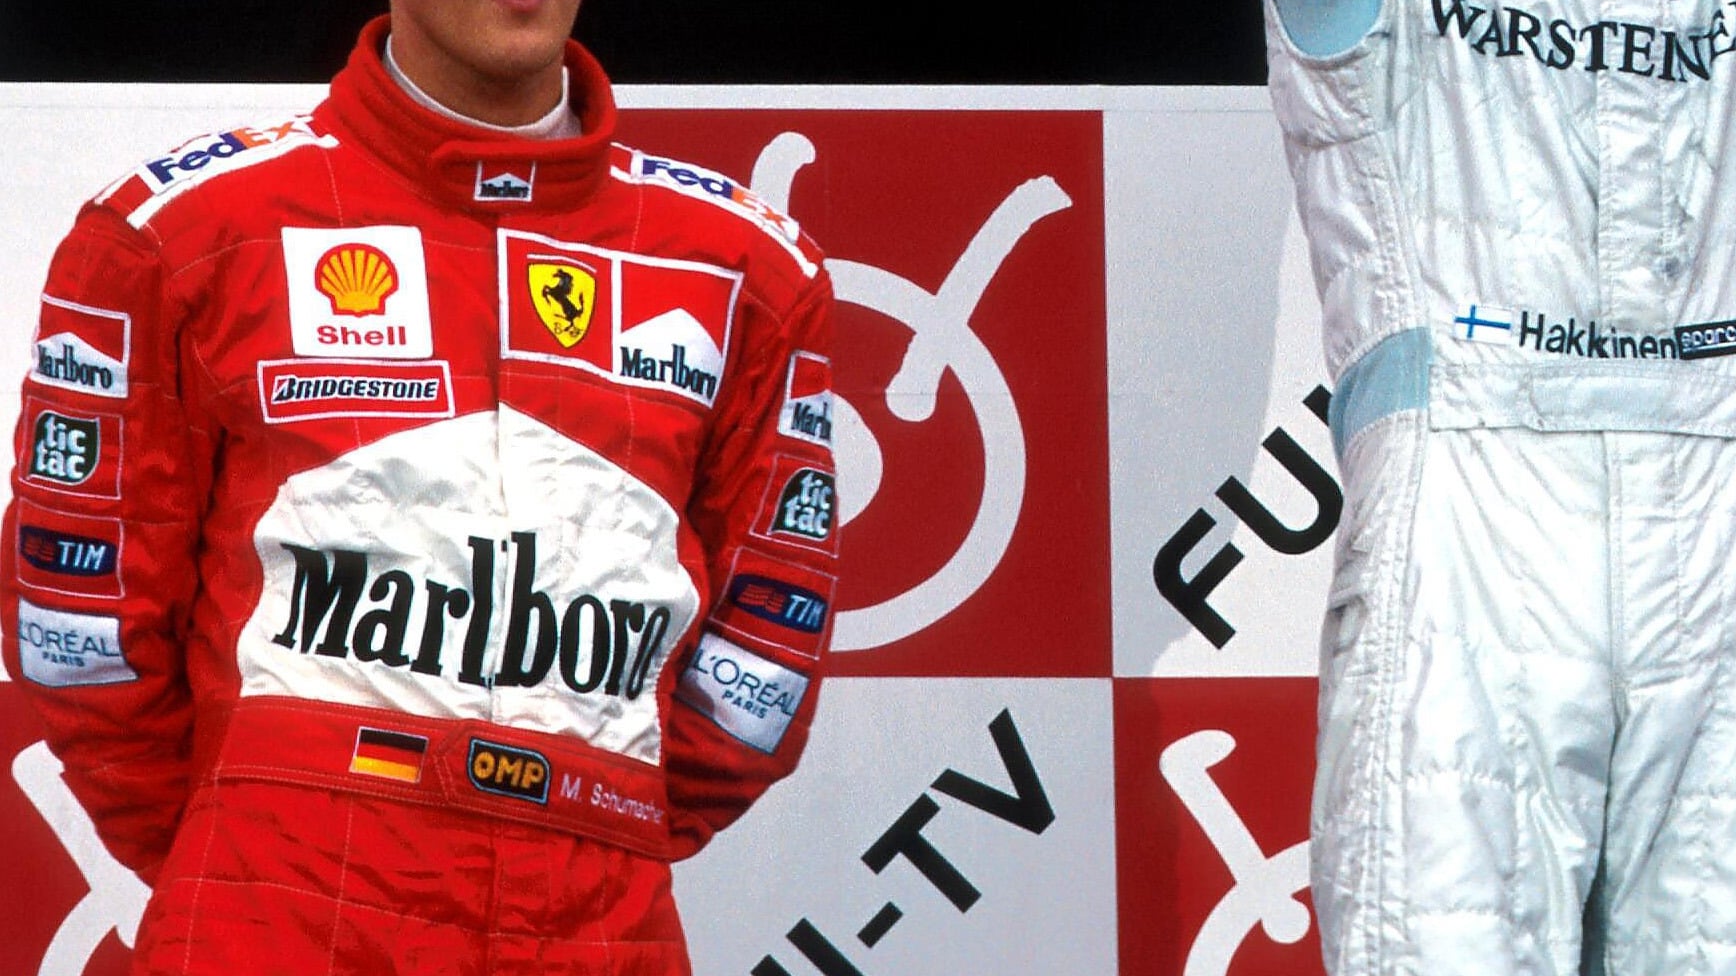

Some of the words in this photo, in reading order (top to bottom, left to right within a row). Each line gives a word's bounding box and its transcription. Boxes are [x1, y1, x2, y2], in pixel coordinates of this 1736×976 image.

[146, 121, 304, 185] FedEx
[643, 158, 789, 231] FedEx
[317, 324, 407, 346] Shell
[1519, 310, 1680, 360] Hakkinen
[273, 374, 439, 403] BRIDGESTONE
[45, 416, 86, 454] tic
[36, 440, 86, 479] tac
[800, 473, 832, 510] tic
[784, 496, 829, 536] tac
[58, 540, 107, 571] TIM
[272, 531, 671, 702] Marlboro
[722, 690, 768, 719] PARIS
[474, 752, 544, 789] OMP
